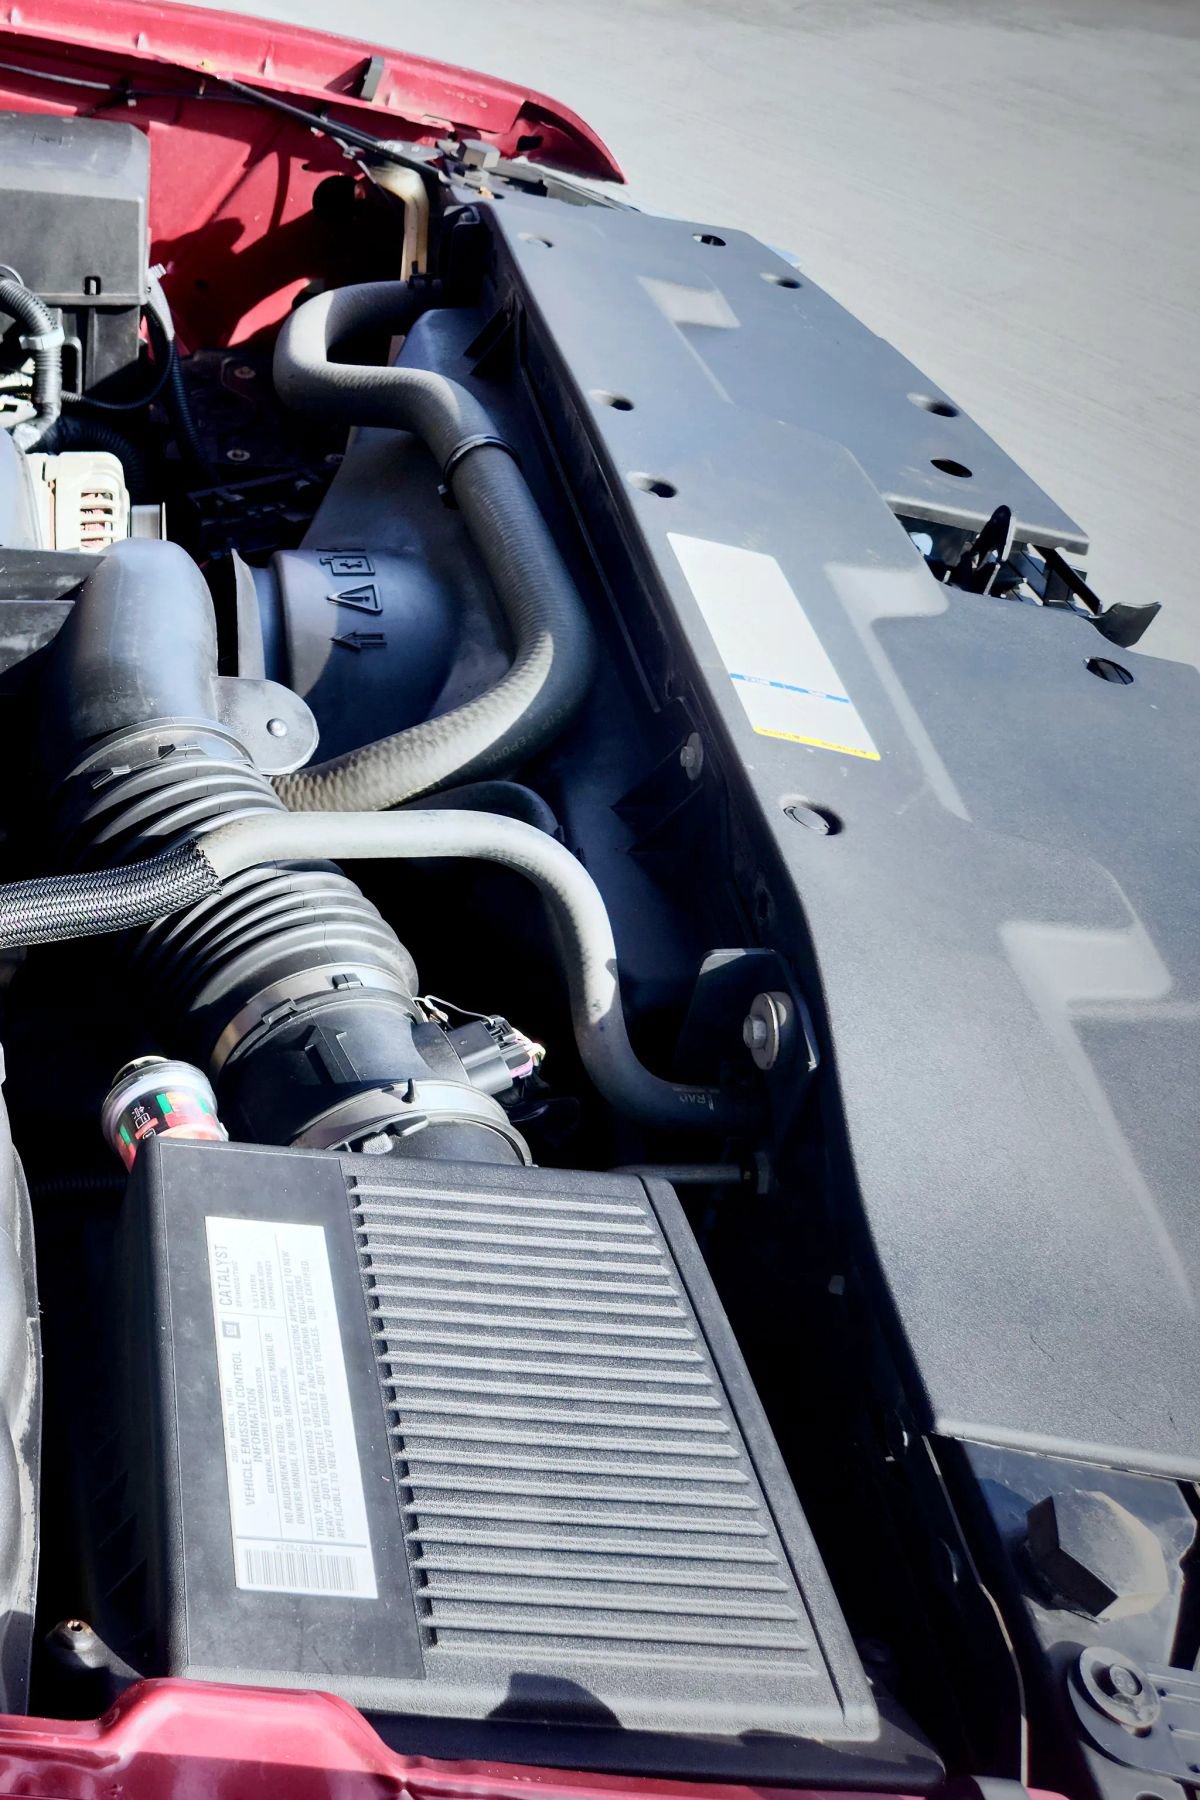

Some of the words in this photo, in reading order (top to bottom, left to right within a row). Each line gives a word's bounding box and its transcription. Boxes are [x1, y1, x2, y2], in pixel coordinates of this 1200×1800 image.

[215, 1245, 232, 1305] CATALYST
[282, 1251, 290, 1266] NEW
[284, 1268, 292, 1277] TO
[286, 1280, 297, 1322] APPLICABLE
[295, 1276, 307, 1324] REGULATIONS
[267, 1345, 276, 1371] MANUAL
[291, 1325, 304, 1375] REGULATIONS
[301, 1327, 313, 1370] CALIFORNIA
[232, 1353, 245, 1398] CONTROL
[270, 1375, 280, 1402] SERVICE
[307, 1373, 316, 1389] AND
[256, 1368, 266, 1419] CORPORATION
[309, 1392, 321, 1428] VEHICLES
[237, 1402, 250, 1454] EMISSION
[247, 1388, 262, 1462] INFORMATION
[273, 1406, 282, 1417] SEE
[285, 1418, 295, 1438] MORE
[302, 1417, 311, 1426] TO
[261, 1423, 270, 1455] MOTORS
[288, 1441, 297, 1455] FOR
[305, 1431, 317, 1475] CONFORMS
[315, 1432, 327, 1473] COMPLETE
[290, 1459, 300, 1489] MANUAL
[327, 1452, 336, 1469] NEW
[329, 1472, 338, 1483] TO
[242, 1459, 255, 1505] VEHICLE
[279, 1456, 292, 1510] ADJUSTMENTS
[310, 1479, 322, 1513] VEHICLE
[315, 1518, 325, 1536] THIS
[332, 1487, 345, 1538] APPLICABLE
